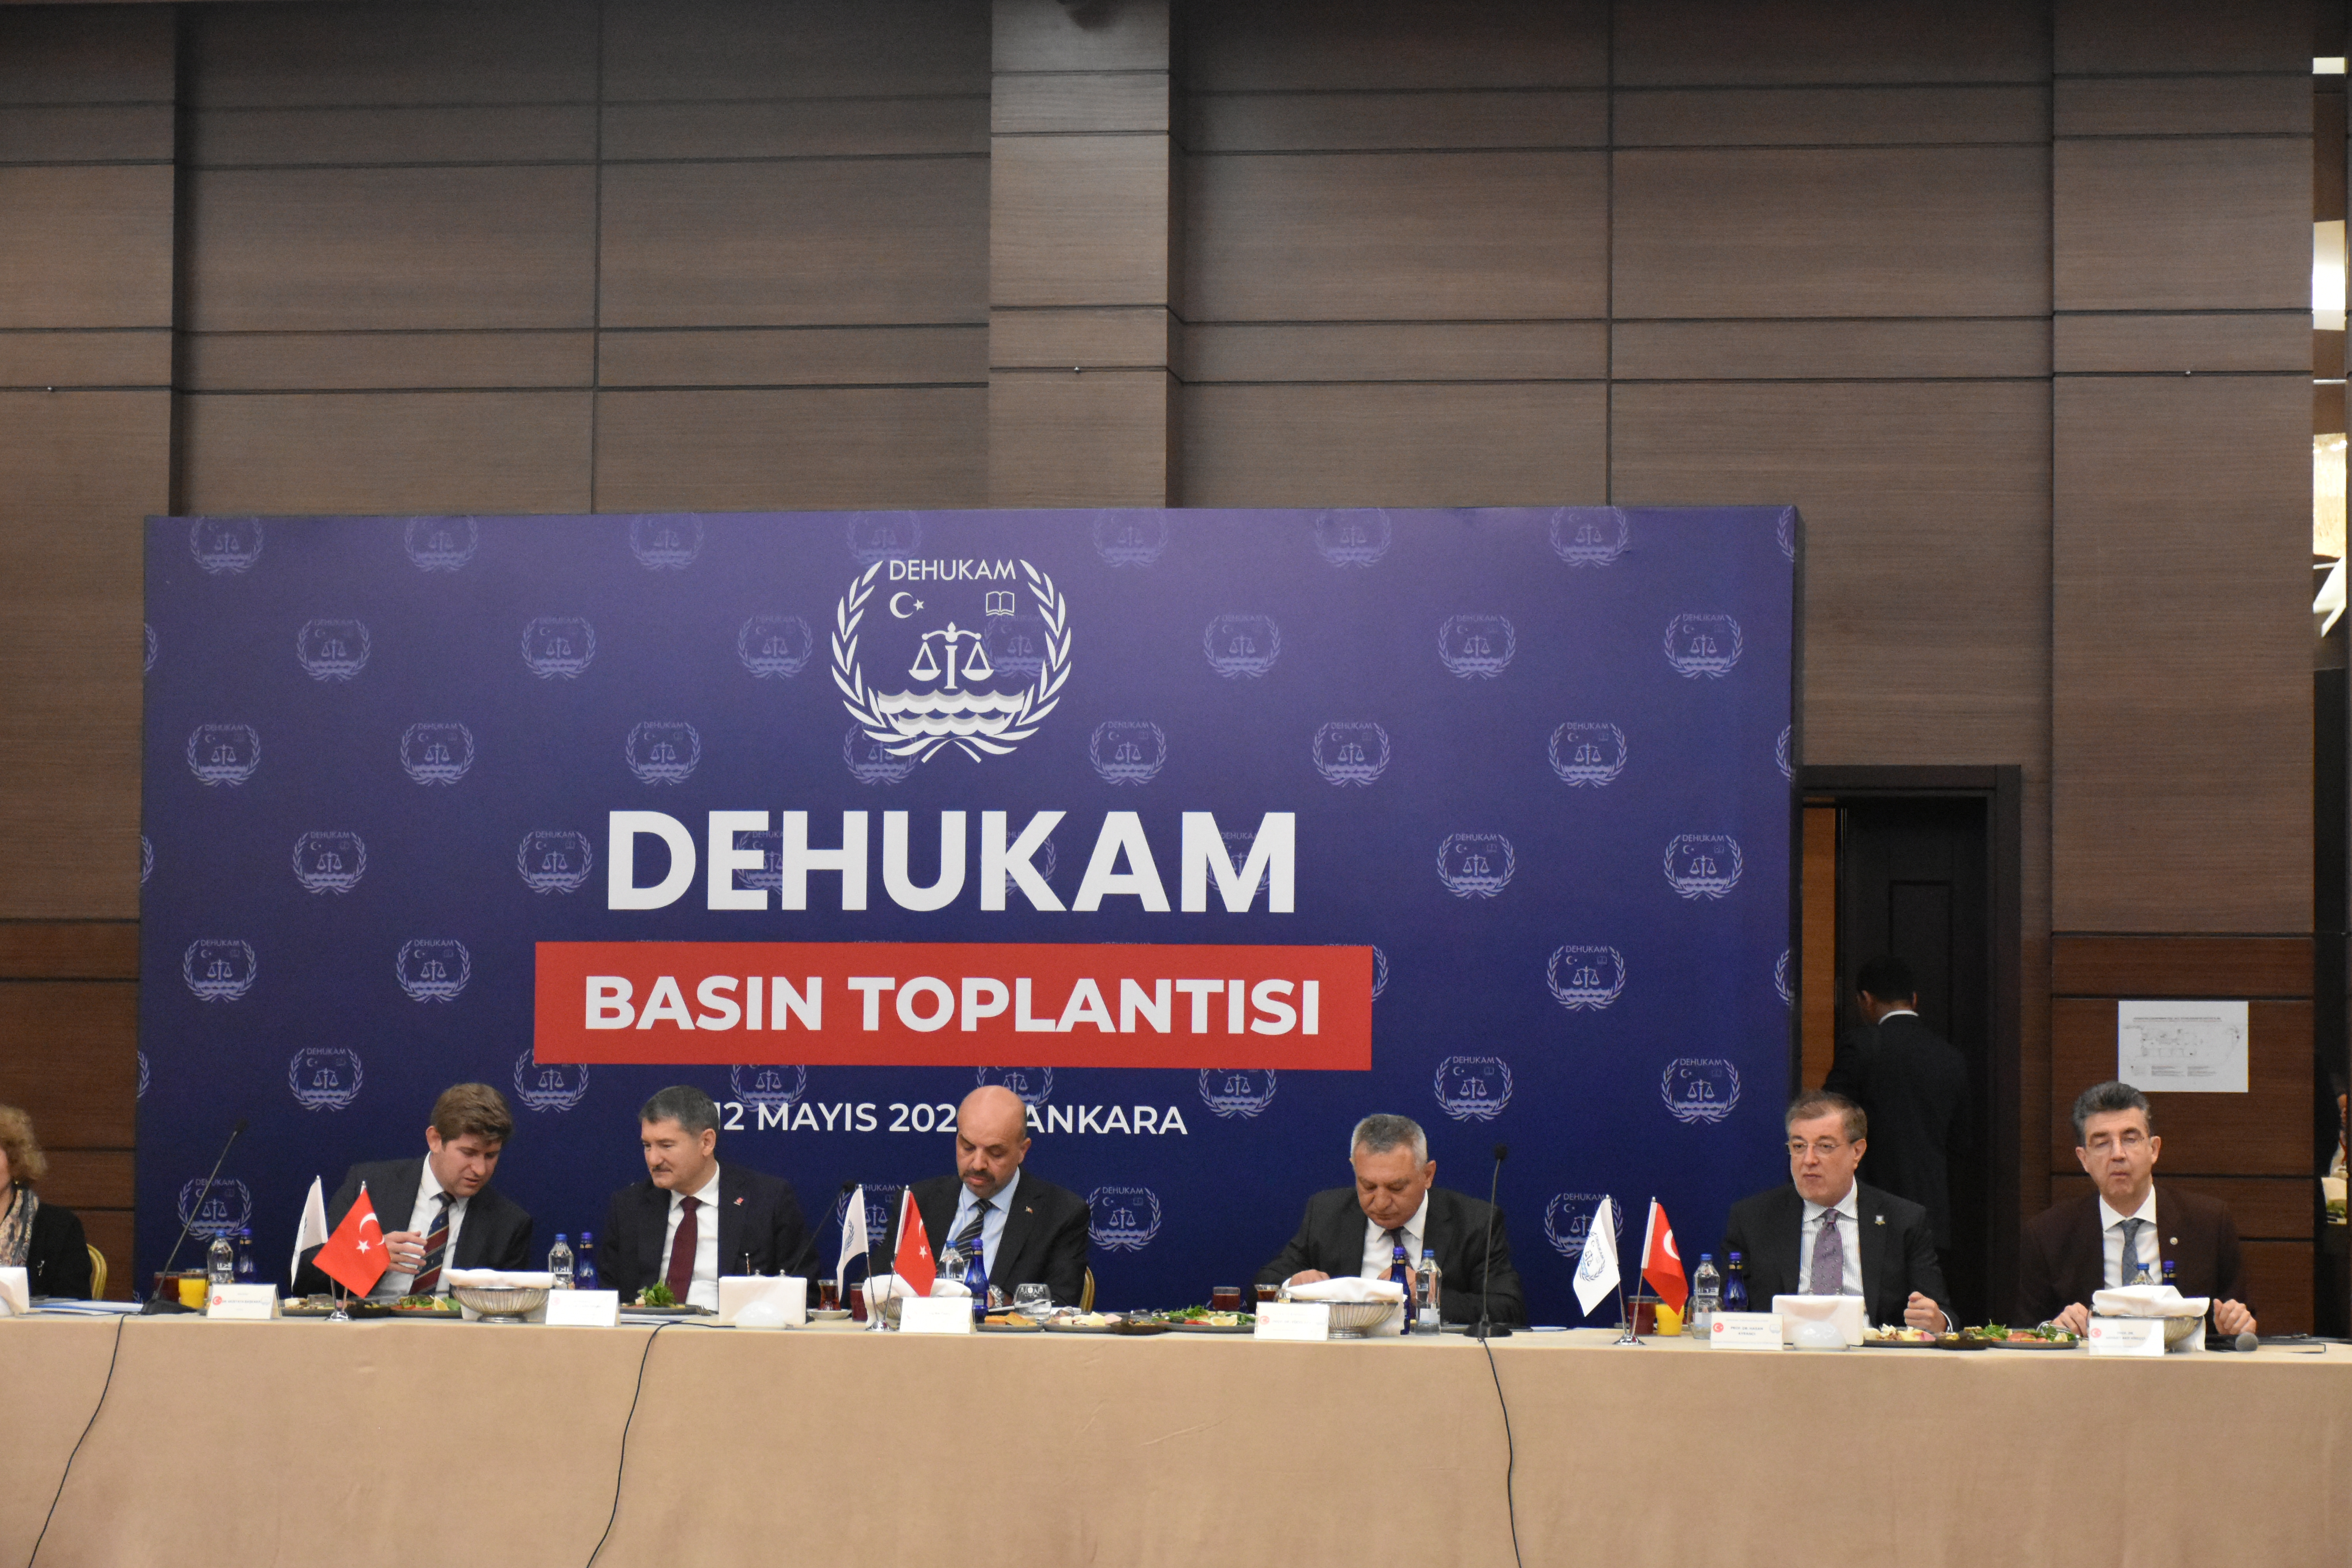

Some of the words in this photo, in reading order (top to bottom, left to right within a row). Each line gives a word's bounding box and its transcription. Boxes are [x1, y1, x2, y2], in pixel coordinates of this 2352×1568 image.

[890, 559, 1016, 581] DEHUKAM
[608, 811, 1295, 913] DEHUKAM
[586, 976, 822, 1031] BASIN
[848, 976, 1319, 1035] TOPLANTISI
[758, 1103, 877, 1131] MAYIS
[889, 1103, 957, 1132] 202
